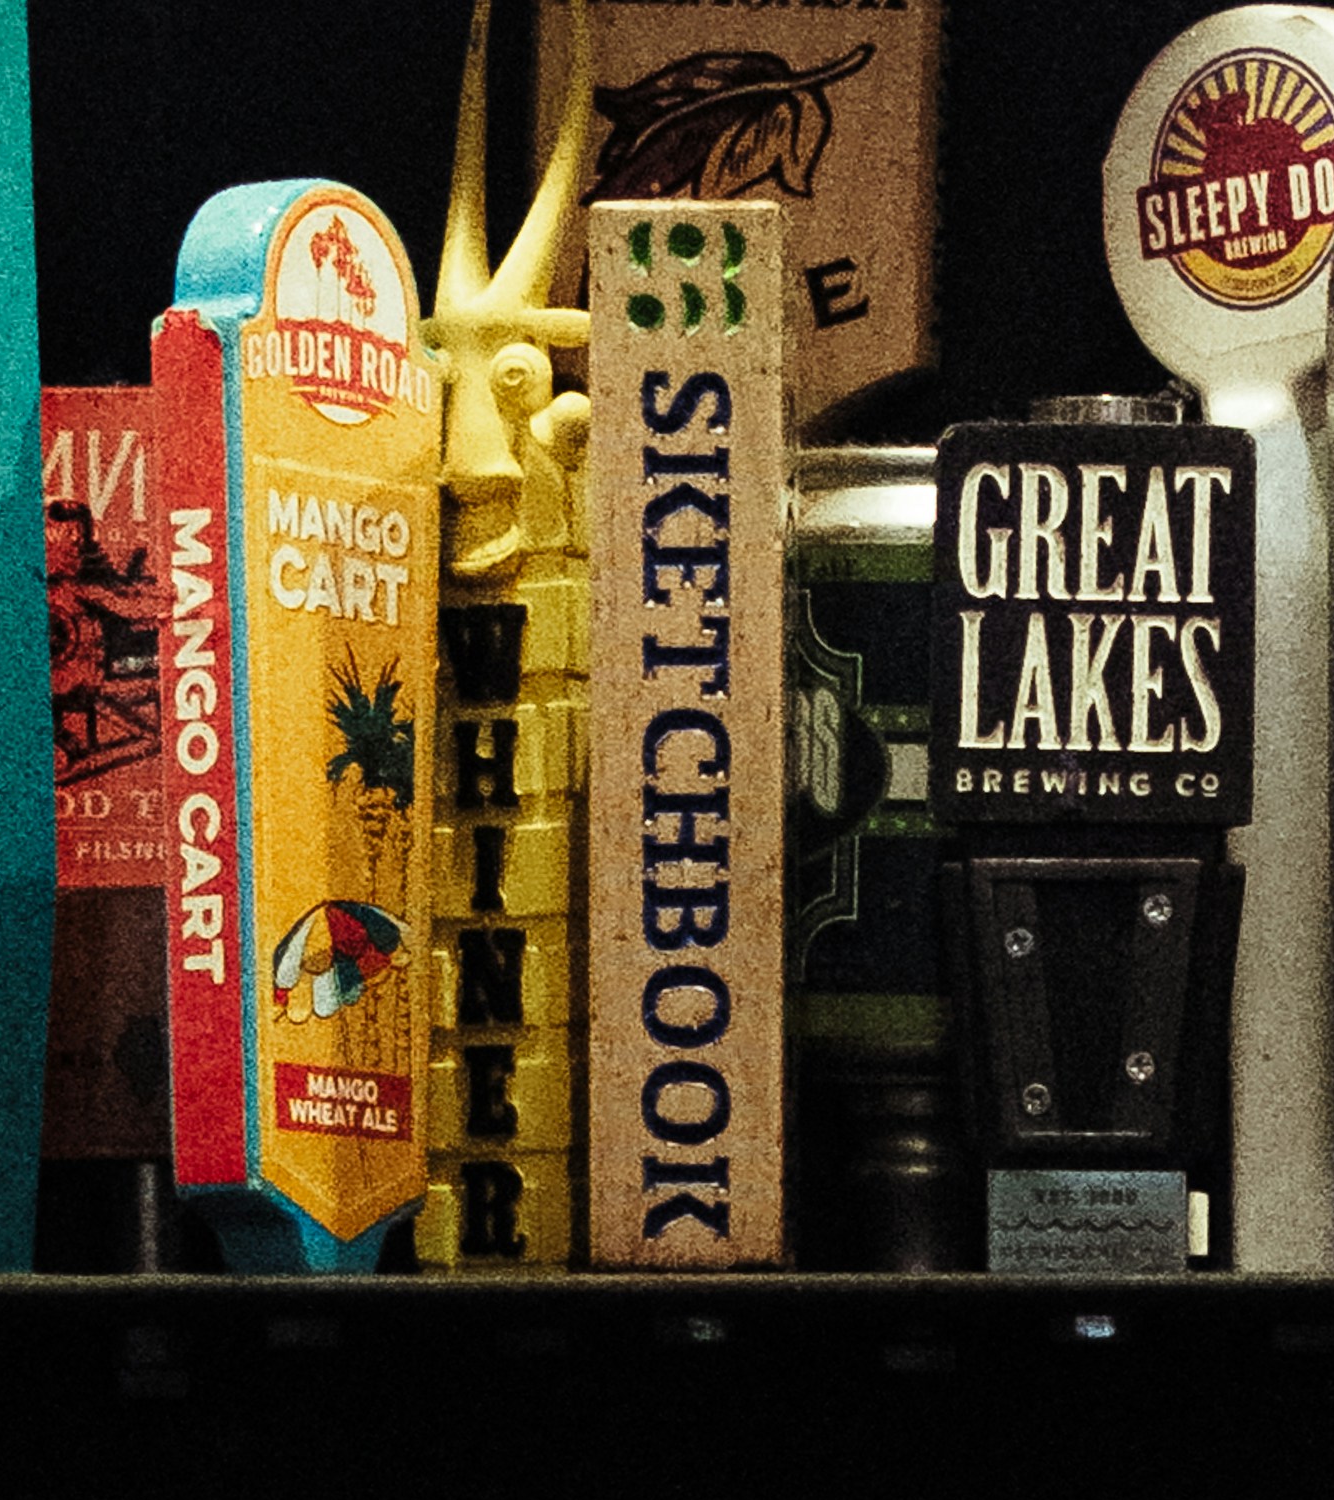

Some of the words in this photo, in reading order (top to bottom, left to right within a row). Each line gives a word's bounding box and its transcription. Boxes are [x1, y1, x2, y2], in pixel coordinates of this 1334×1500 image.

[1145, 172, 1270, 249] SLEEPY
[247, 328, 354, 390] GOLDEN
[360, 341, 431, 415] ROAD
[267, 490, 411, 560] MANGO
[958, 461, 1234, 604] GREAT
[267, 545, 412, 628] CART
[168, 507, 220, 775] MANGO
[957, 609, 1225, 753] LAKES
[640, 370, 733, 1240] SKETCHBOOK
[954, 767, 1153, 798] BREWING
[177, 794, 227, 986] CART
[437, 602, 527, 1255] WHINER
[288, 1098, 358, 1130] WHEAT
[357, 1104, 400, 1134] ALE
[306, 1072, 381, 1105] MANGO
